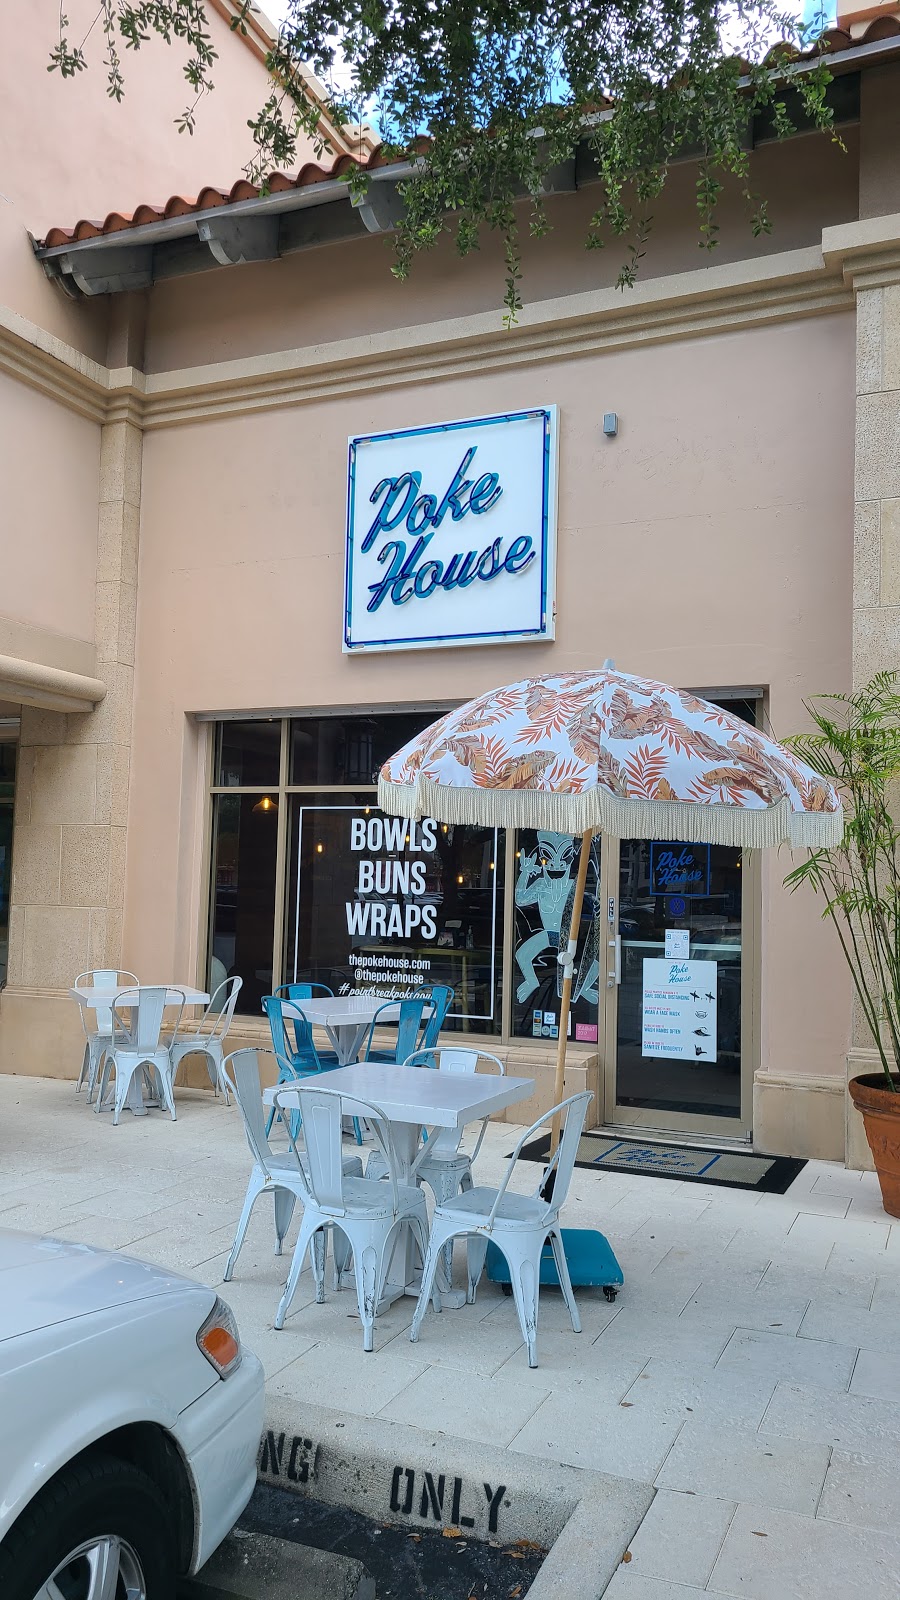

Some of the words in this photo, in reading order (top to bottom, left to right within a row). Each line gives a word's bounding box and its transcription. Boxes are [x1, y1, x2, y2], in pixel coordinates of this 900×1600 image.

[361, 446, 503, 553] Poke
[367, 532, 536, 612] House
[350, 817, 438, 852] BOWLS
[656, 847, 694, 871] Poke
[358, 860, 427, 895] BUNS
[657, 867, 704, 886] House
[345, 902, 438, 939] WRAPS
[348, 953, 432, 970] thepokehouse.com
[669, 963, 689, 975] Poke
[354, 968, 425, 985] @thepokehouse
[668, 973, 692, 984] House
[389, 1465, 507, 1533] ONLY
